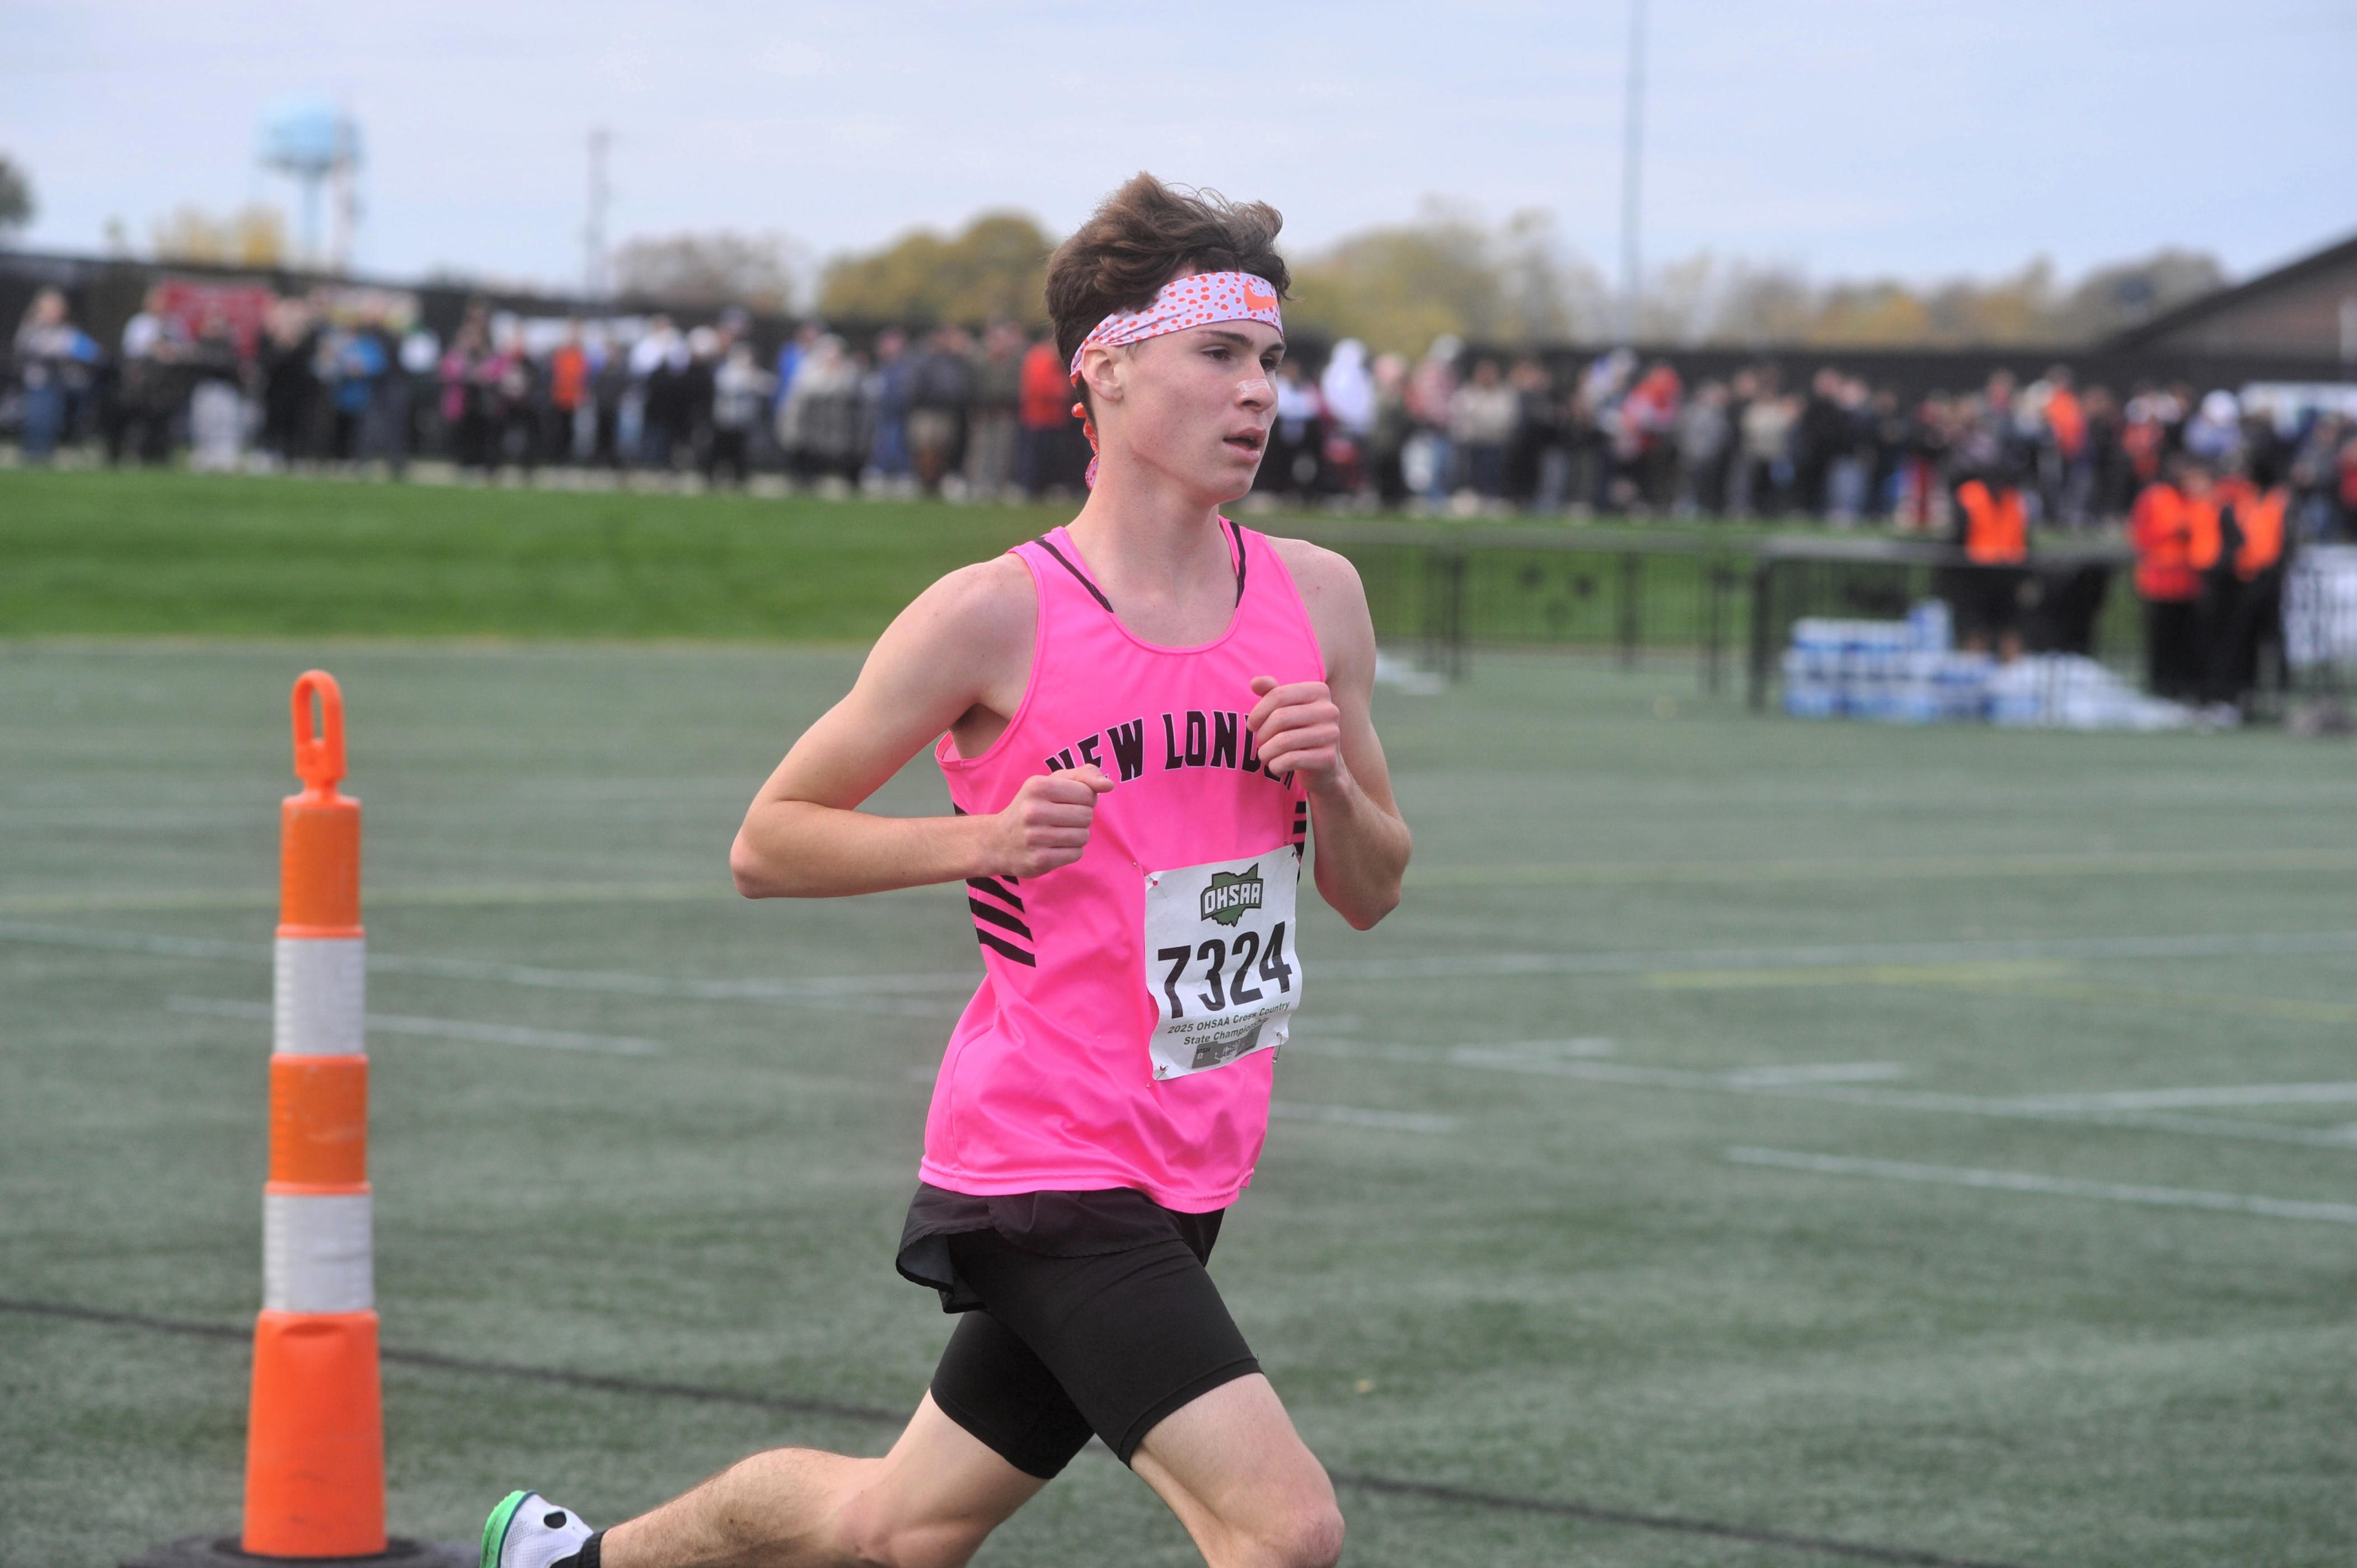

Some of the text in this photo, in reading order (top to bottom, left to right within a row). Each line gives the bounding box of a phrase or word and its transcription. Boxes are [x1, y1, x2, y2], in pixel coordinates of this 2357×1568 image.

[1161, 710, 1295, 792] LOND
[1204, 883, 1261, 914] OHSAA
[1158, 921, 1292, 1019] 7324
[1168, 1002, 1290, 1034] 2025 OHSAA Cross Country
[1183, 1034, 1210, 1045] State
